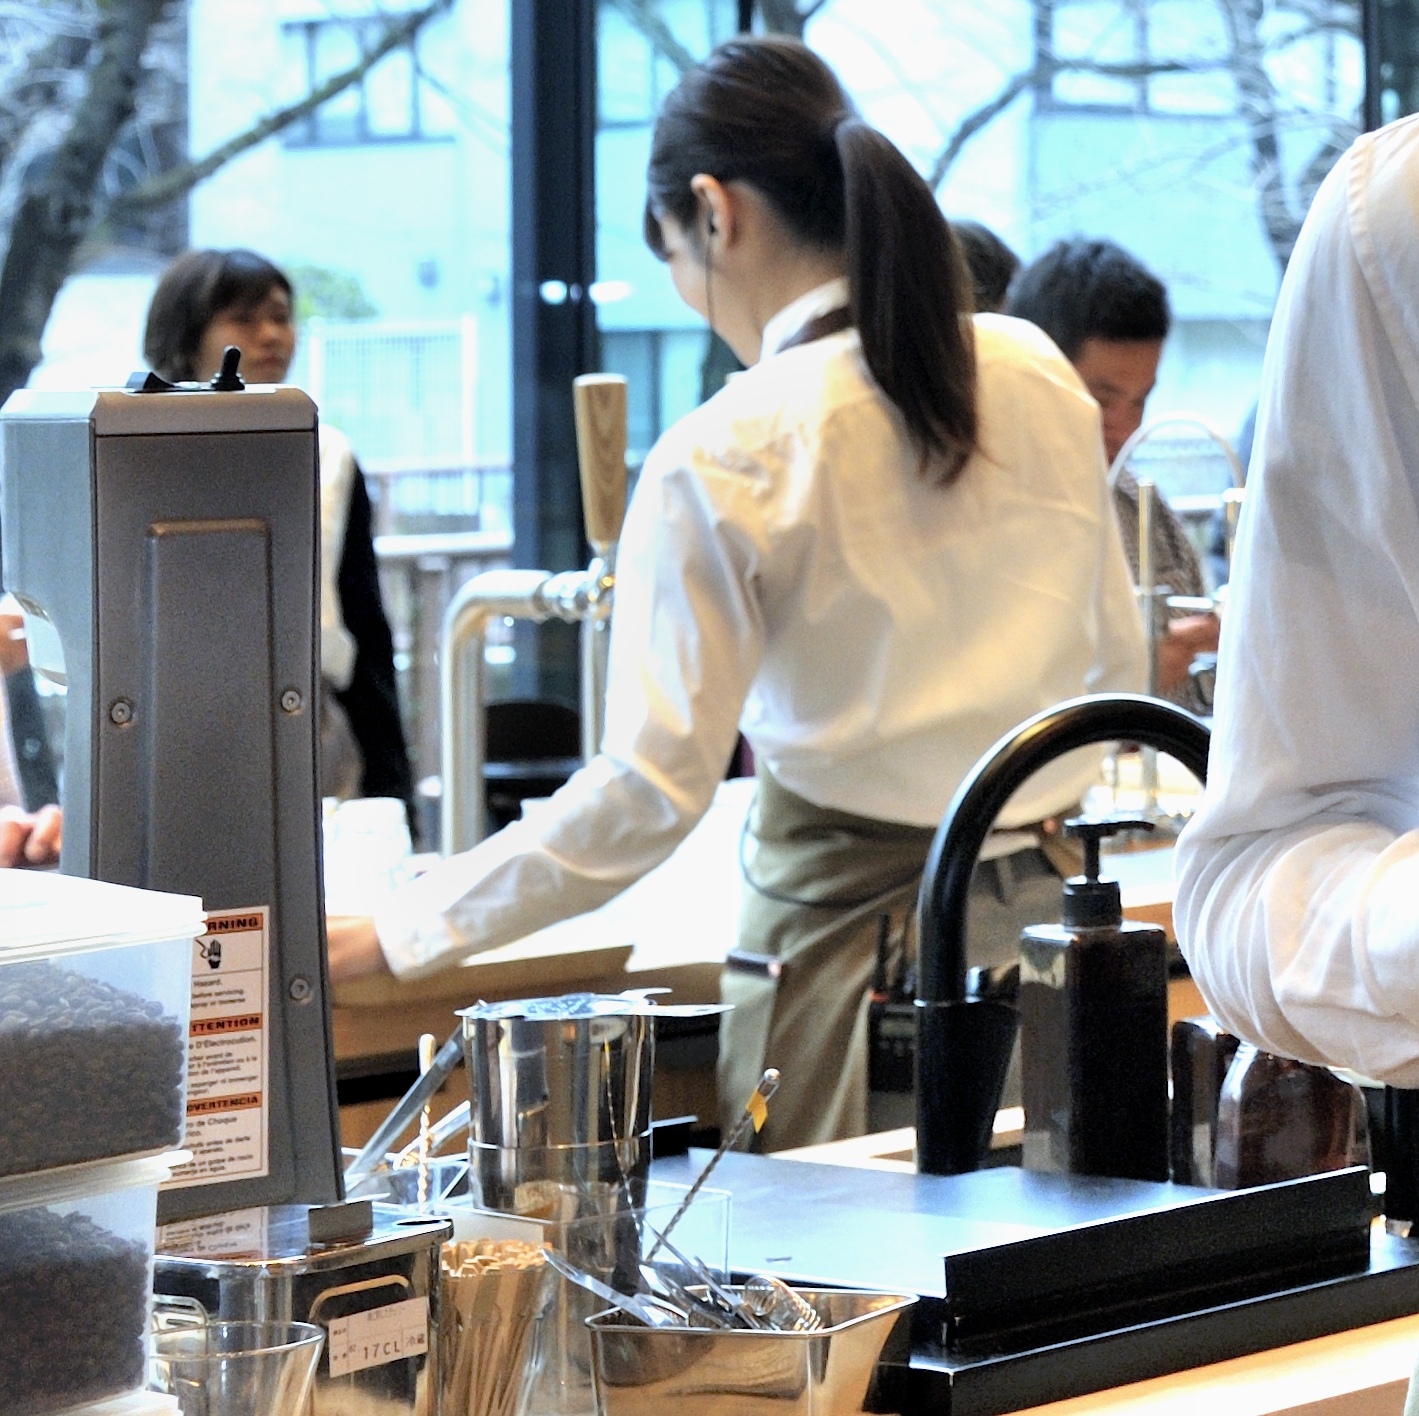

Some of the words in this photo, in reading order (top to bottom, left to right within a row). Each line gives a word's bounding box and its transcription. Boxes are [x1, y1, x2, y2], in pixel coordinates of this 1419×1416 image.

[208, 917, 259, 931] RNING
[193, 1017, 260, 1032] TTENTION
[187, 1095, 259, 1113] DVERTENCIA
[363, 1340, 401, 1360] 17CL
